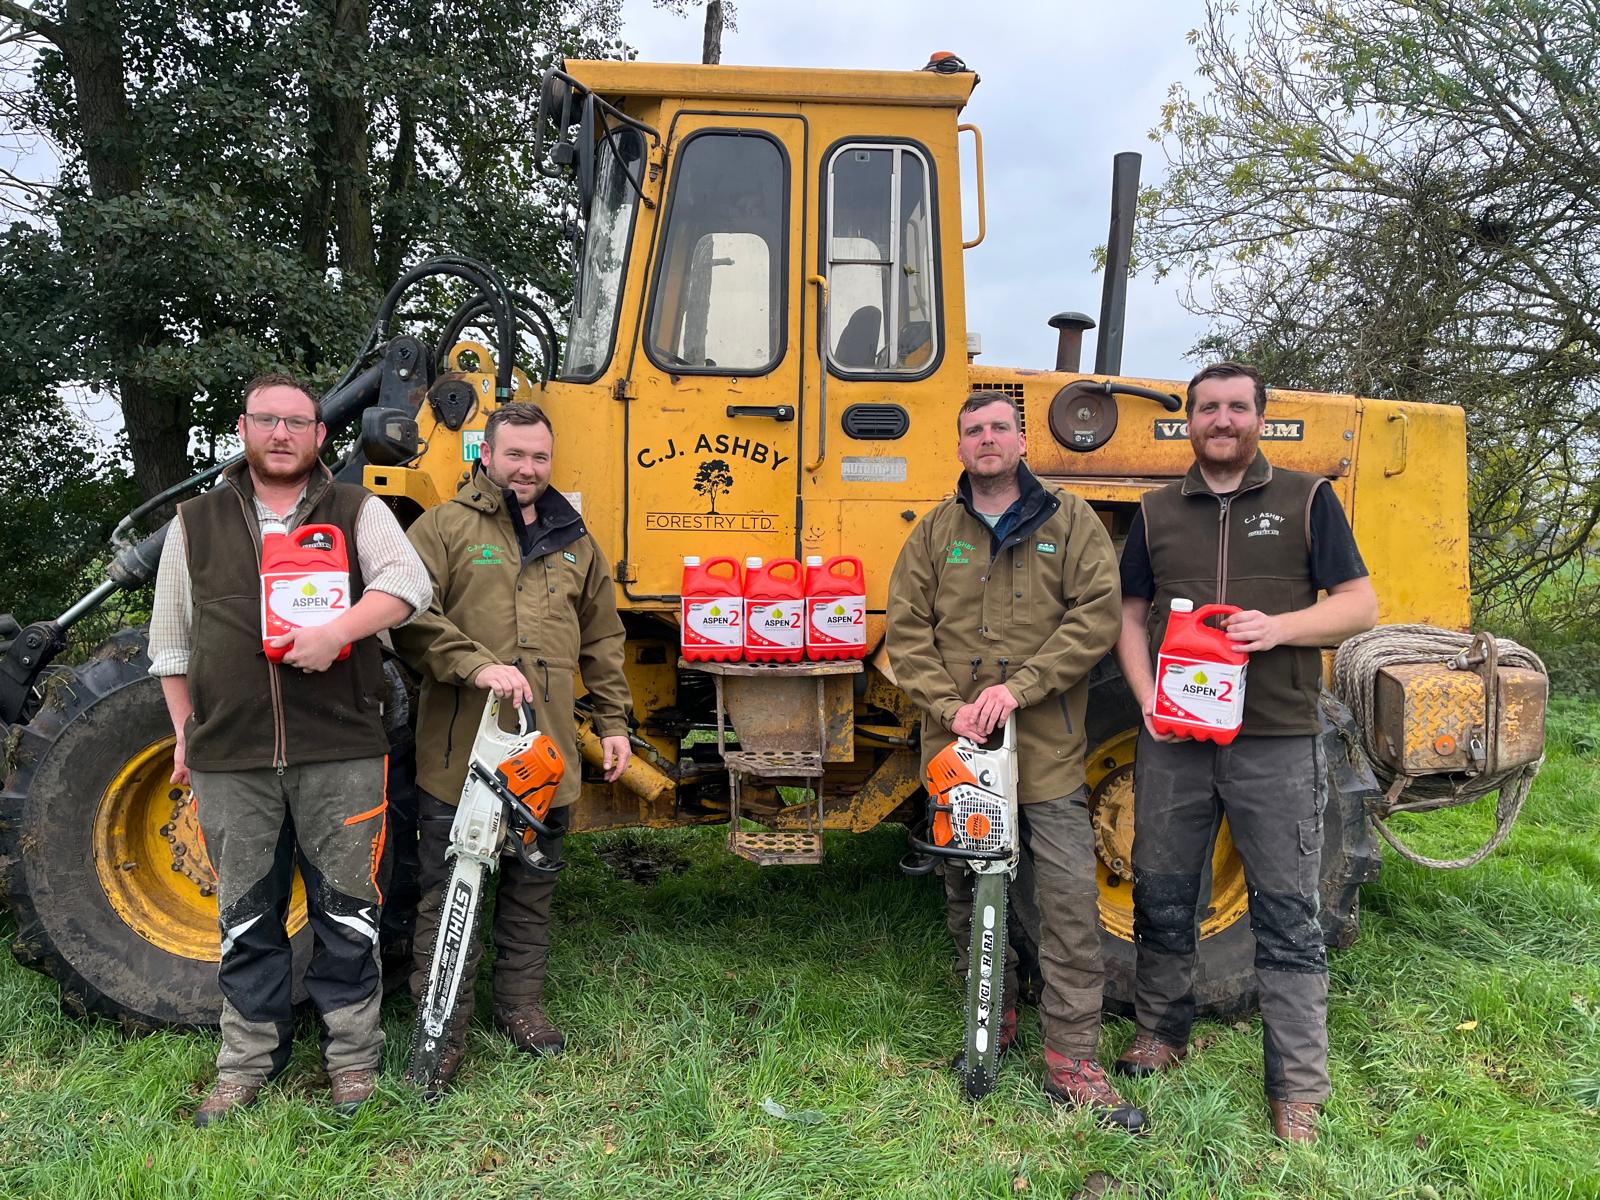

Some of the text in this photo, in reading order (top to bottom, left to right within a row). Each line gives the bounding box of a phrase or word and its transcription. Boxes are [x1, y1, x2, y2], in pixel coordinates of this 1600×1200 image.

[637, 433, 789, 471] C.J. ASHBY
[646, 514, 775, 530] FORESTRY LTD.
[1259, 512, 1286, 522] ASHBY
[952, 540, 976, 551] ASHBY
[292, 587, 345, 609] ASPEN 2
[729, 610, 740, 626] 2
[764, 612, 801, 628] ASPEN 2
[852, 609, 863, 625] 2
[1182, 684, 1217, 697] ASPEN
[1217, 681, 1233, 702] 2
[446, 888, 470, 946] STIHL
[440, 944, 451, 969] LIGHT
